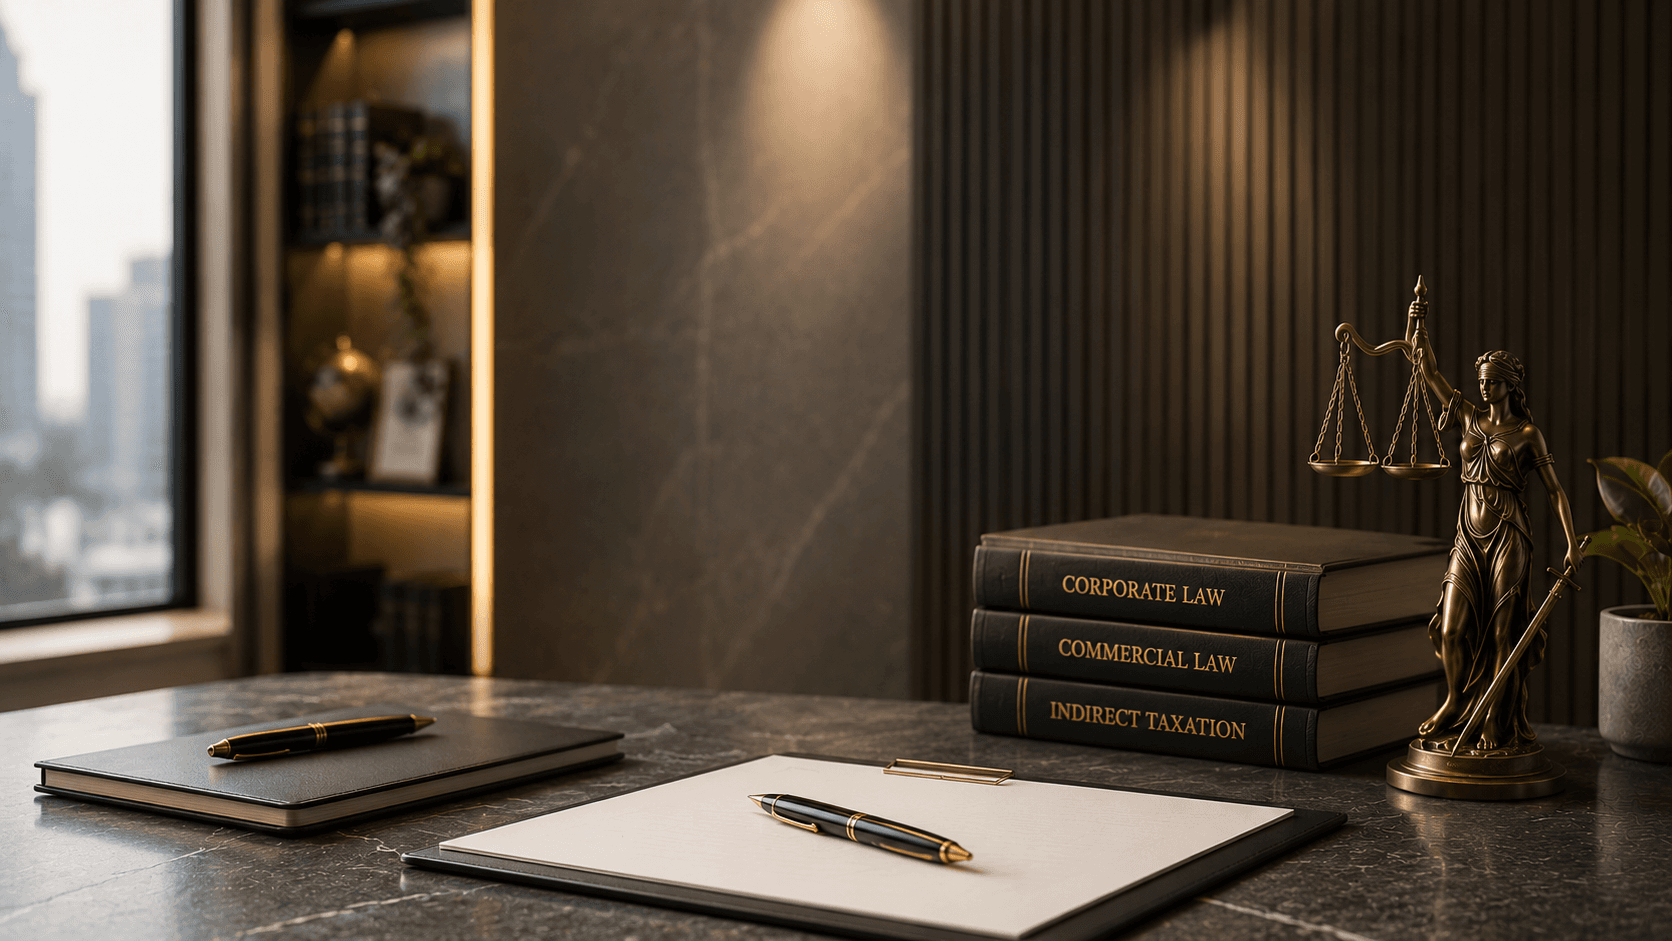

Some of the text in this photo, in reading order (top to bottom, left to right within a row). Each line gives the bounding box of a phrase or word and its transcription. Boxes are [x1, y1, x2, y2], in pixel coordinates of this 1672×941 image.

[1062, 575, 1226, 607] CORPORATE LAW
[1058, 638, 1238, 674] COMMERCIAL LAW
[1050, 701, 1246, 740] INDIRECT TAXATION
